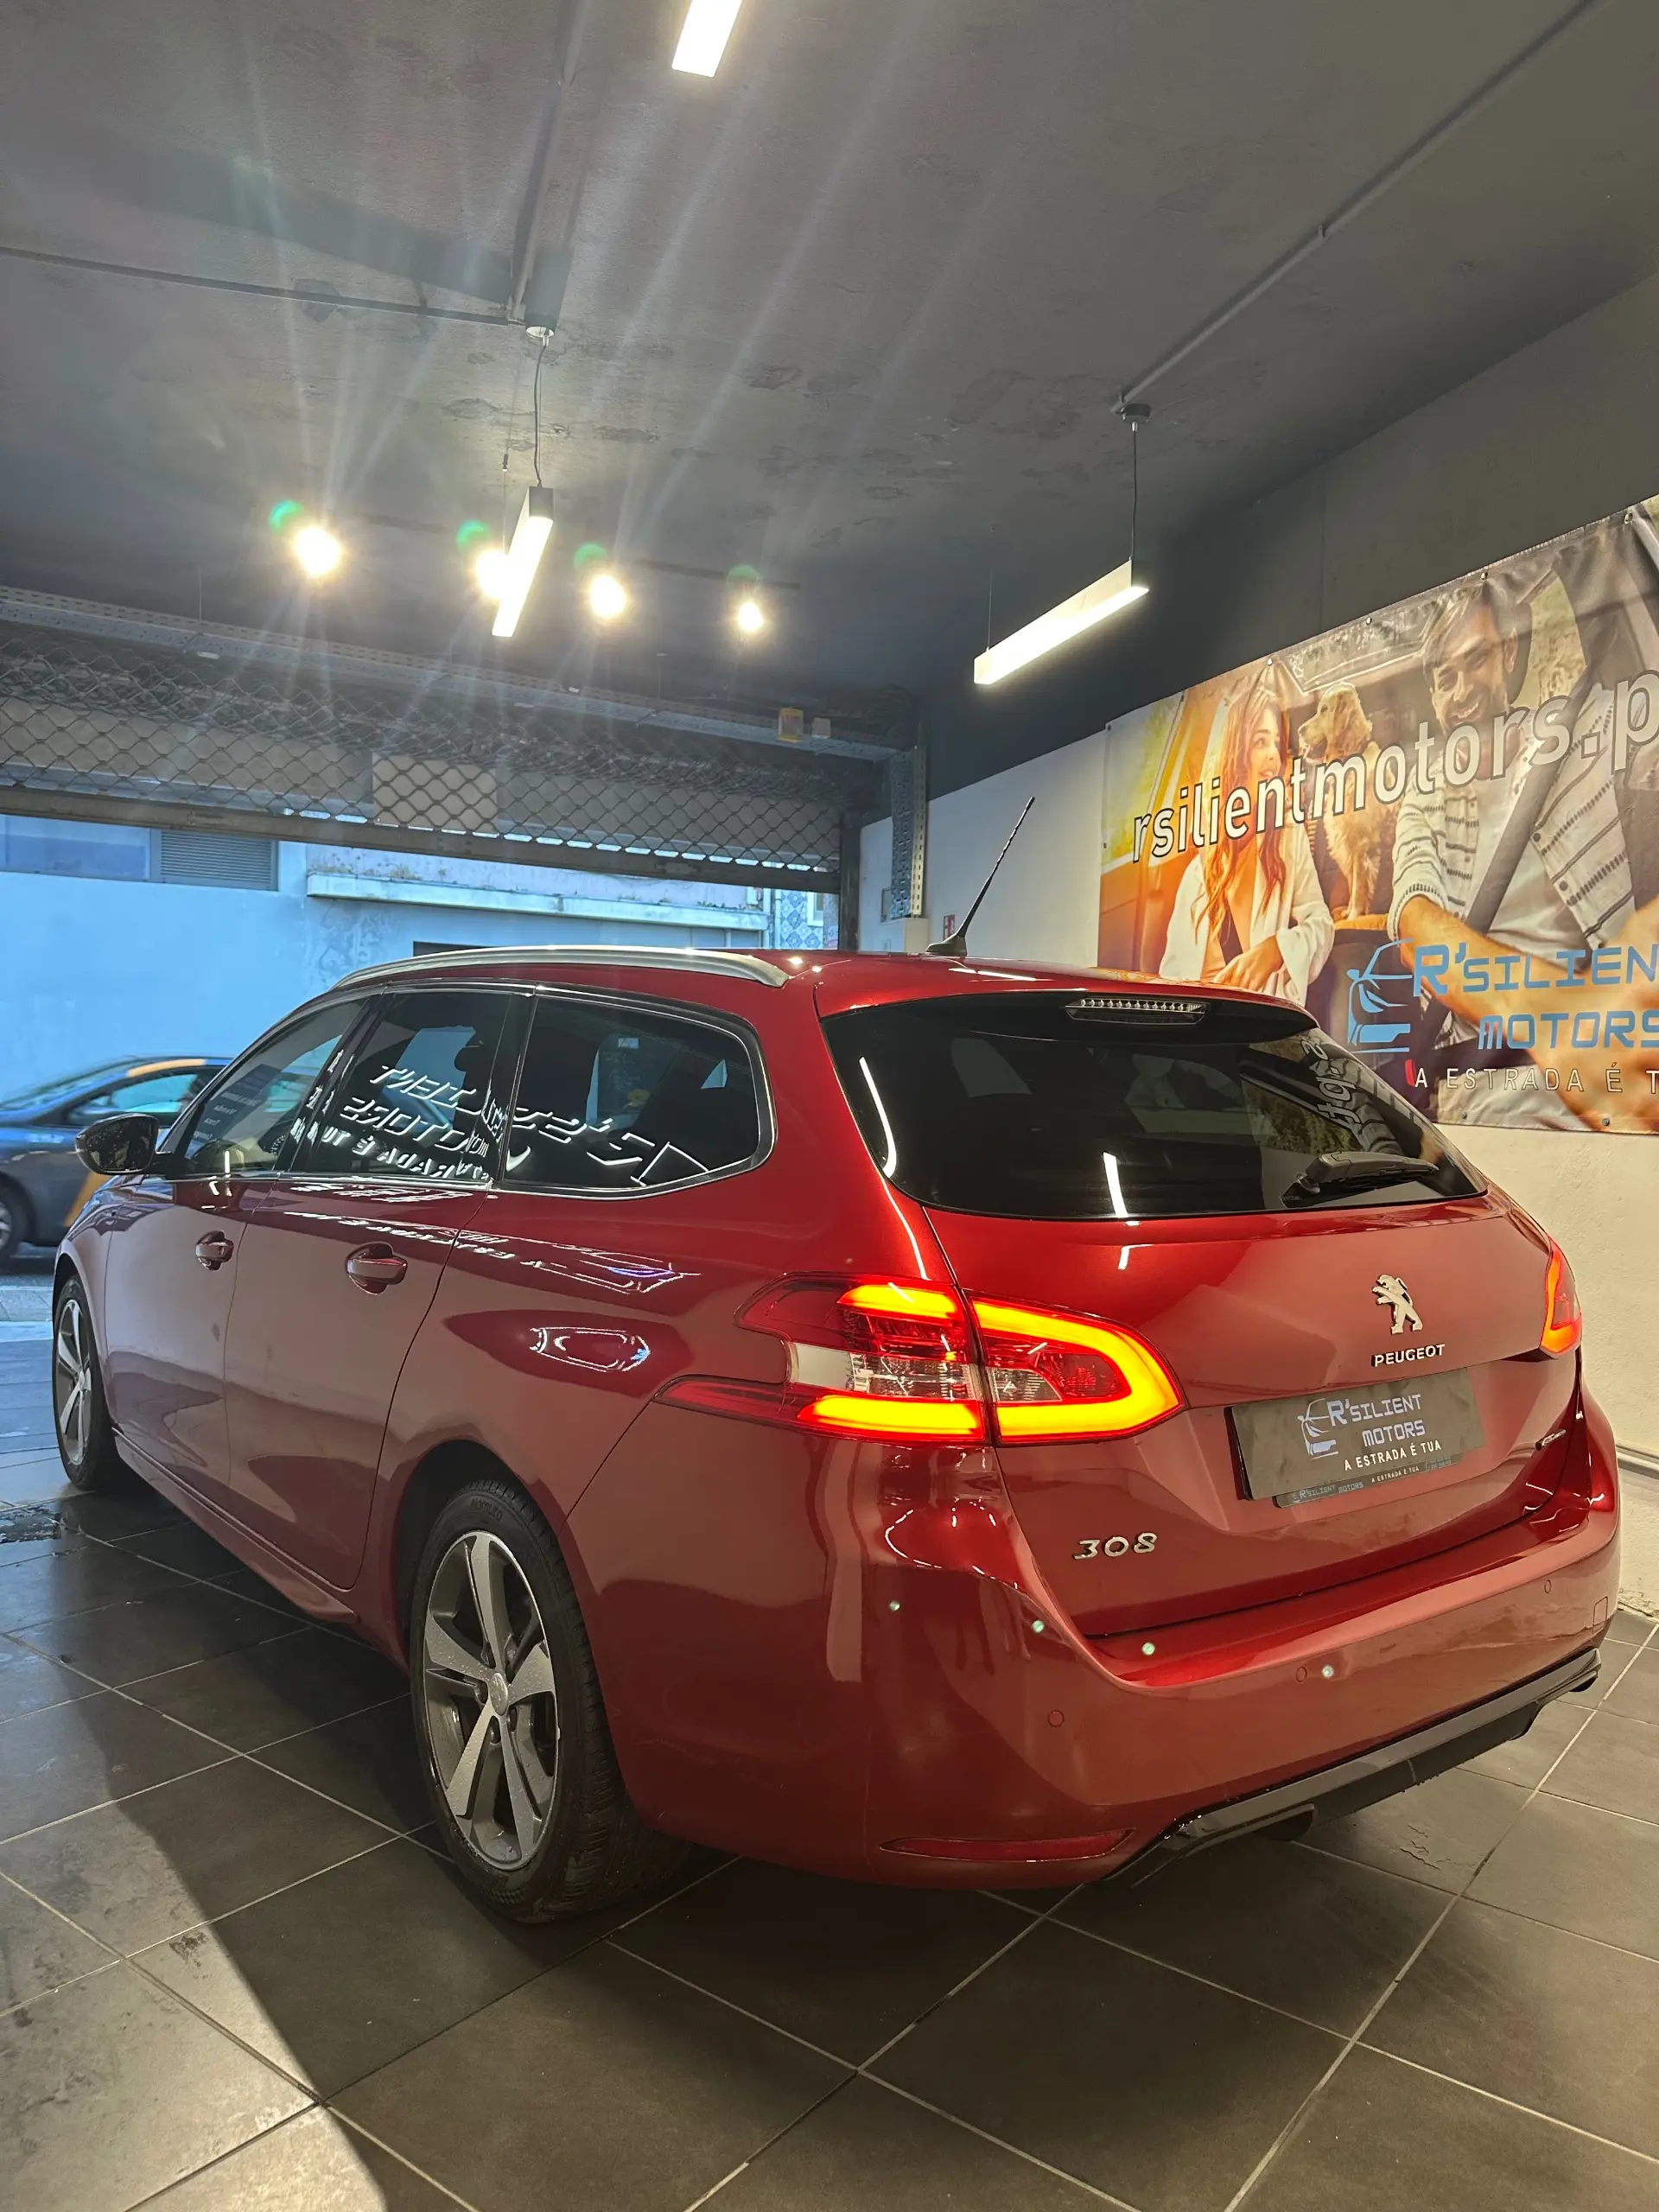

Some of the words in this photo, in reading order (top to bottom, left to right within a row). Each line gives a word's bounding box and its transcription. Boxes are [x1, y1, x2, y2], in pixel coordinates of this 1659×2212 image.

[1413, 943, 1659, 998] R'SILIEN
[1478, 1008, 1659, 1051] MOTORS
[1414, 1067, 1428, 1089] A
[1446, 1068, 1585, 1093] ESTRADA
[1605, 1062, 1623, 1093] É
[1372, 1344, 1446, 1368] PEUGEOT
[1326, 1393, 1421, 1427] R'SILIENT
[1362, 1419, 1426, 1447] MOTORS
[1344, 1459, 1352, 1471] A
[1356, 1446, 1408, 1469] ESTRADA
[1410, 1442, 1417, 1456] É
[1421, 1440, 1442, 1454] TUA
[1376, 1470, 1402, 1483] ESTRADA
[1408, 1465, 1420, 1473] TUA
[1073, 1531, 1158, 1560] 308
